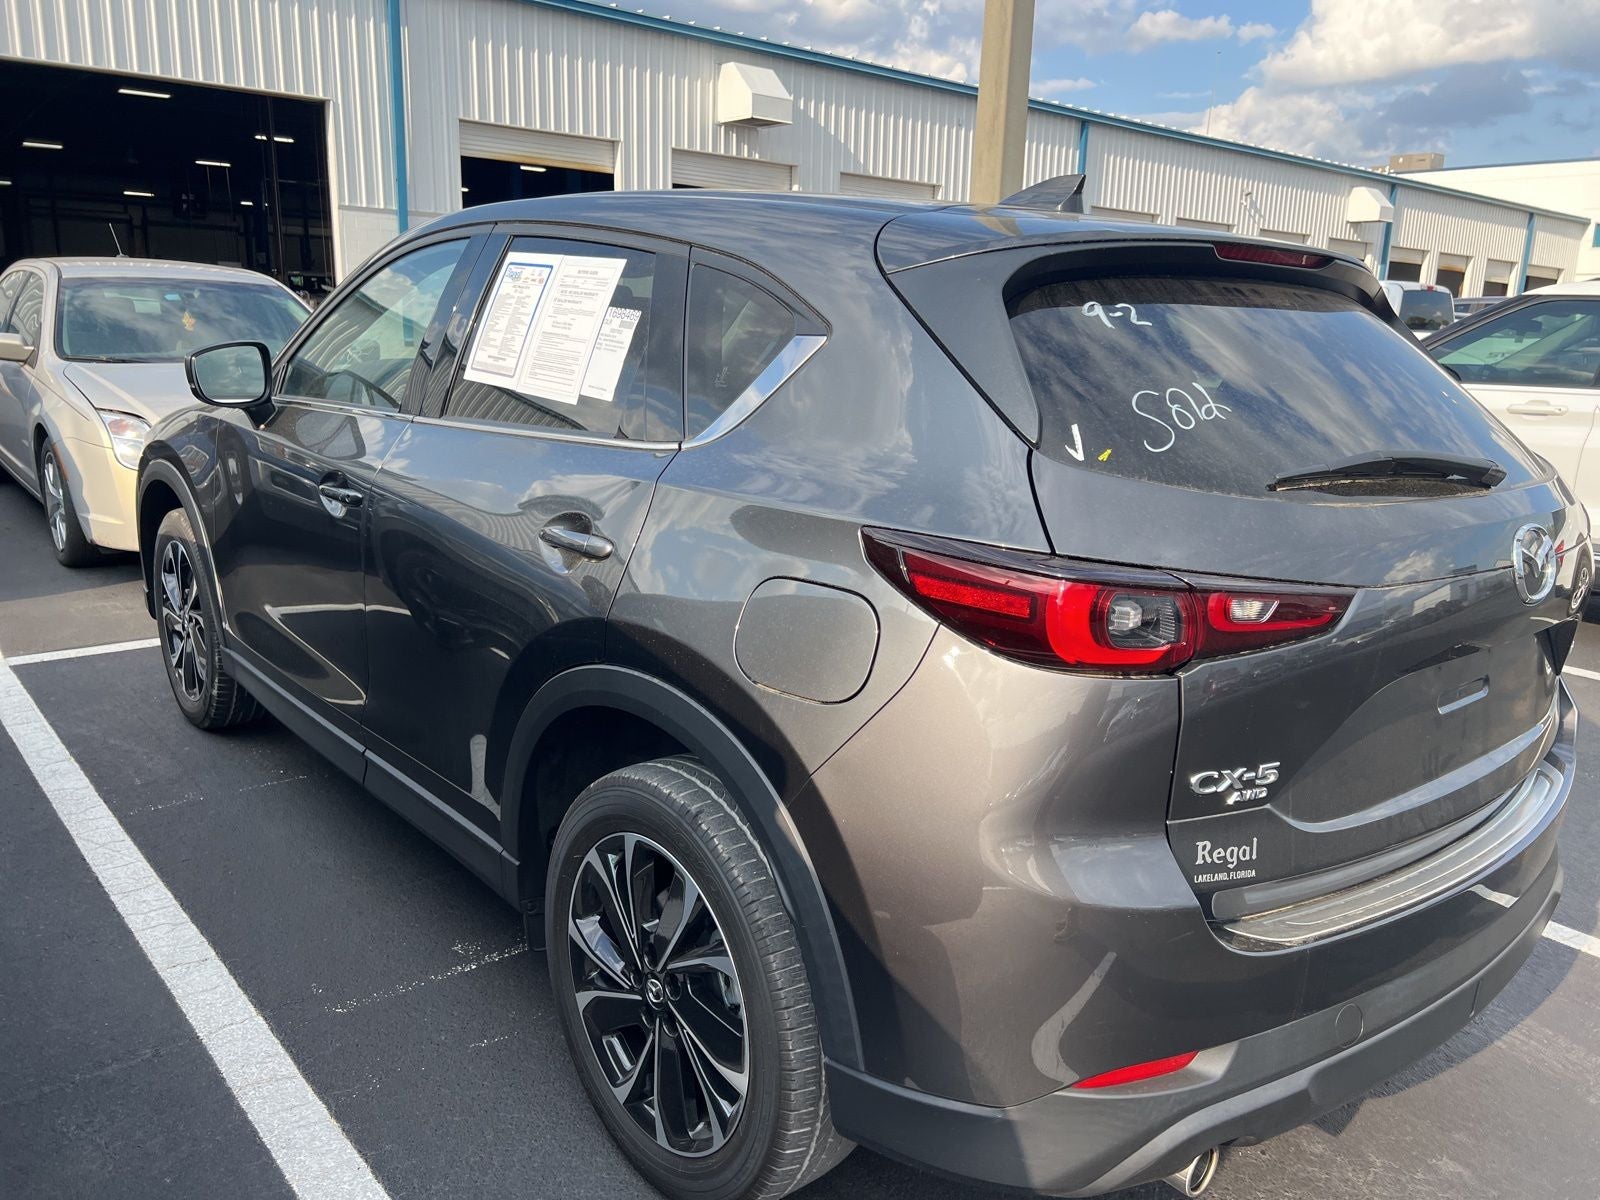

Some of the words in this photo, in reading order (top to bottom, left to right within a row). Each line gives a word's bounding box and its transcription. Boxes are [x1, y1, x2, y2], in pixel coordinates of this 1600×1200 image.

[1190, 762, 1280, 794] CX-5
[1225, 787, 1269, 805] AWD
[1195, 837, 1258, 869] Regal
[1194, 873, 1229, 883] LAKELAND,
[1229, 869, 1256, 880] FLORIDA
